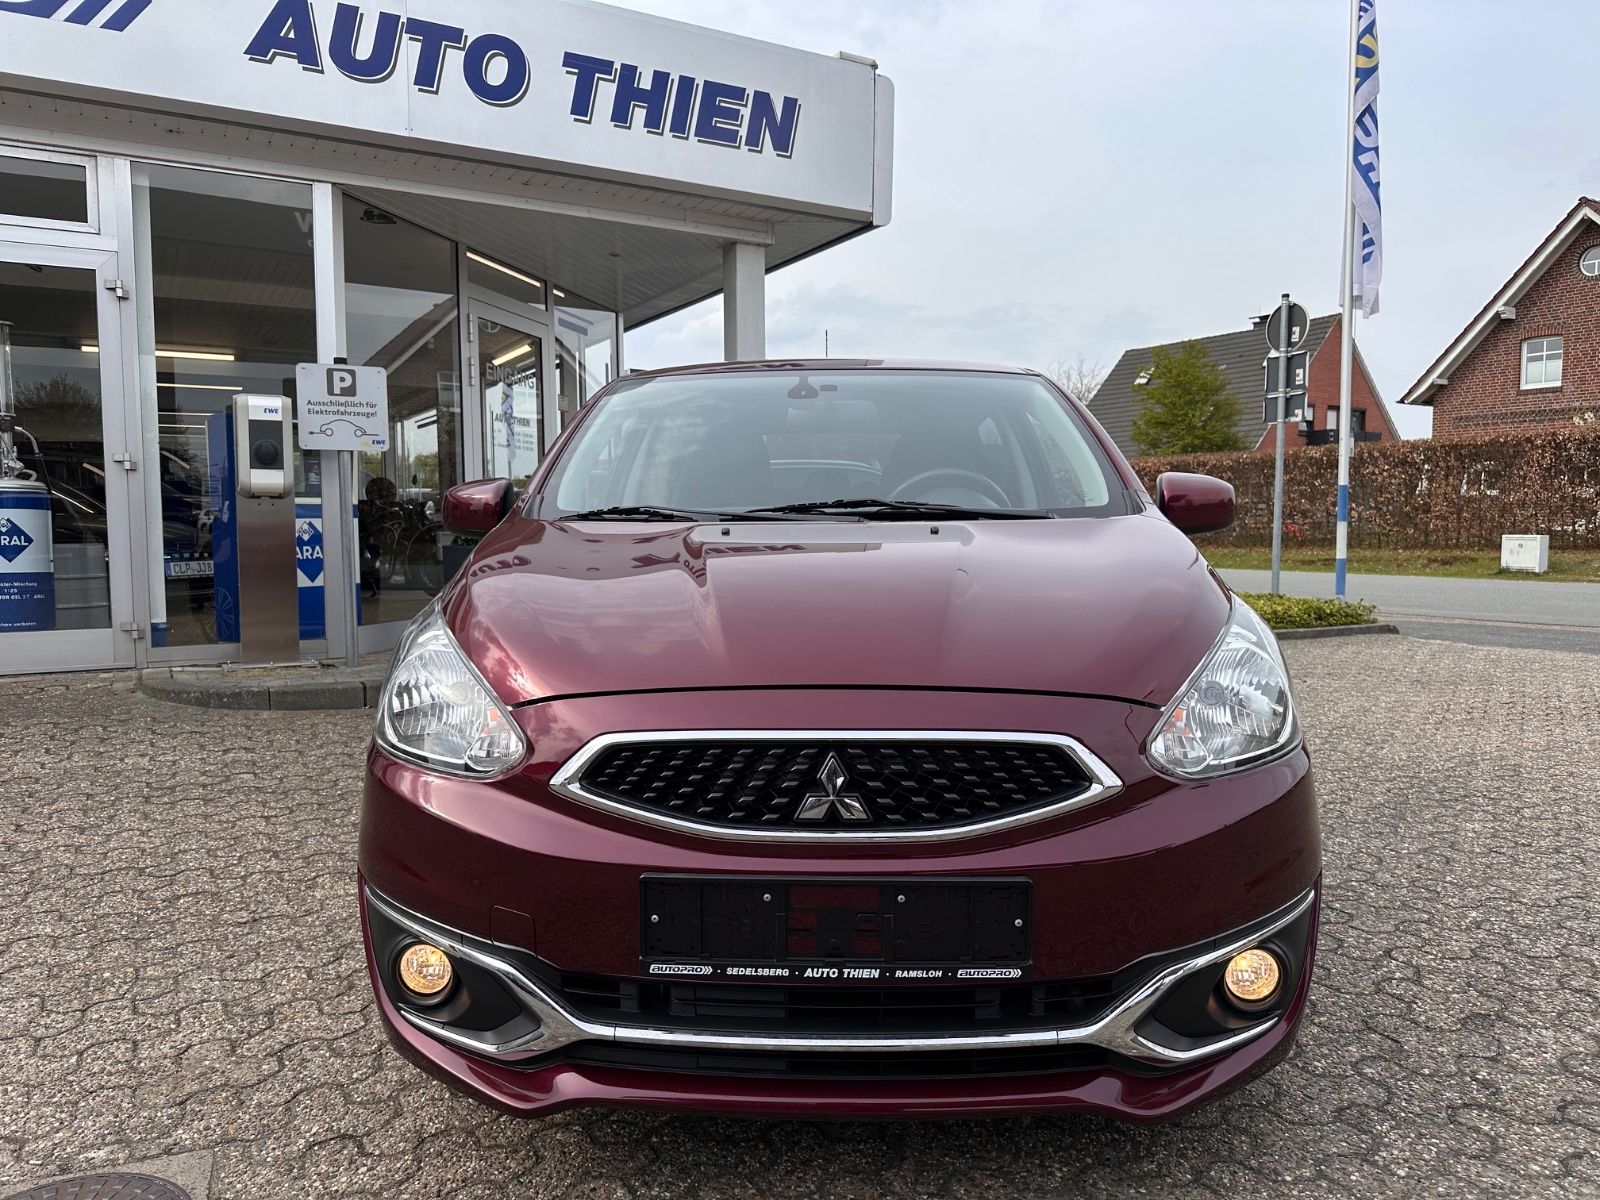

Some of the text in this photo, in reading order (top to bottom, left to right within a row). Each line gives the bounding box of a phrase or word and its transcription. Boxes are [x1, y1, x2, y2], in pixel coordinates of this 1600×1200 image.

[243, 0, 801, 158] AUTO THIEN
[486, 361, 535, 389] EINGANG
[333, 371, 353, 395] P
[306, 399, 364, 408] Ausschließlich
[307, 408, 378, 419] Elektrofahrzeuge!
[513, 416, 531, 428] THIEN
[173, 563, 191, 575] CLP
[726, 967, 790, 977] SEDELSBERG
[803, 967, 839, 978] AUTO
[842, 968, 880, 979] THIEN
[895, 970, 943, 978] RAMSLOH
